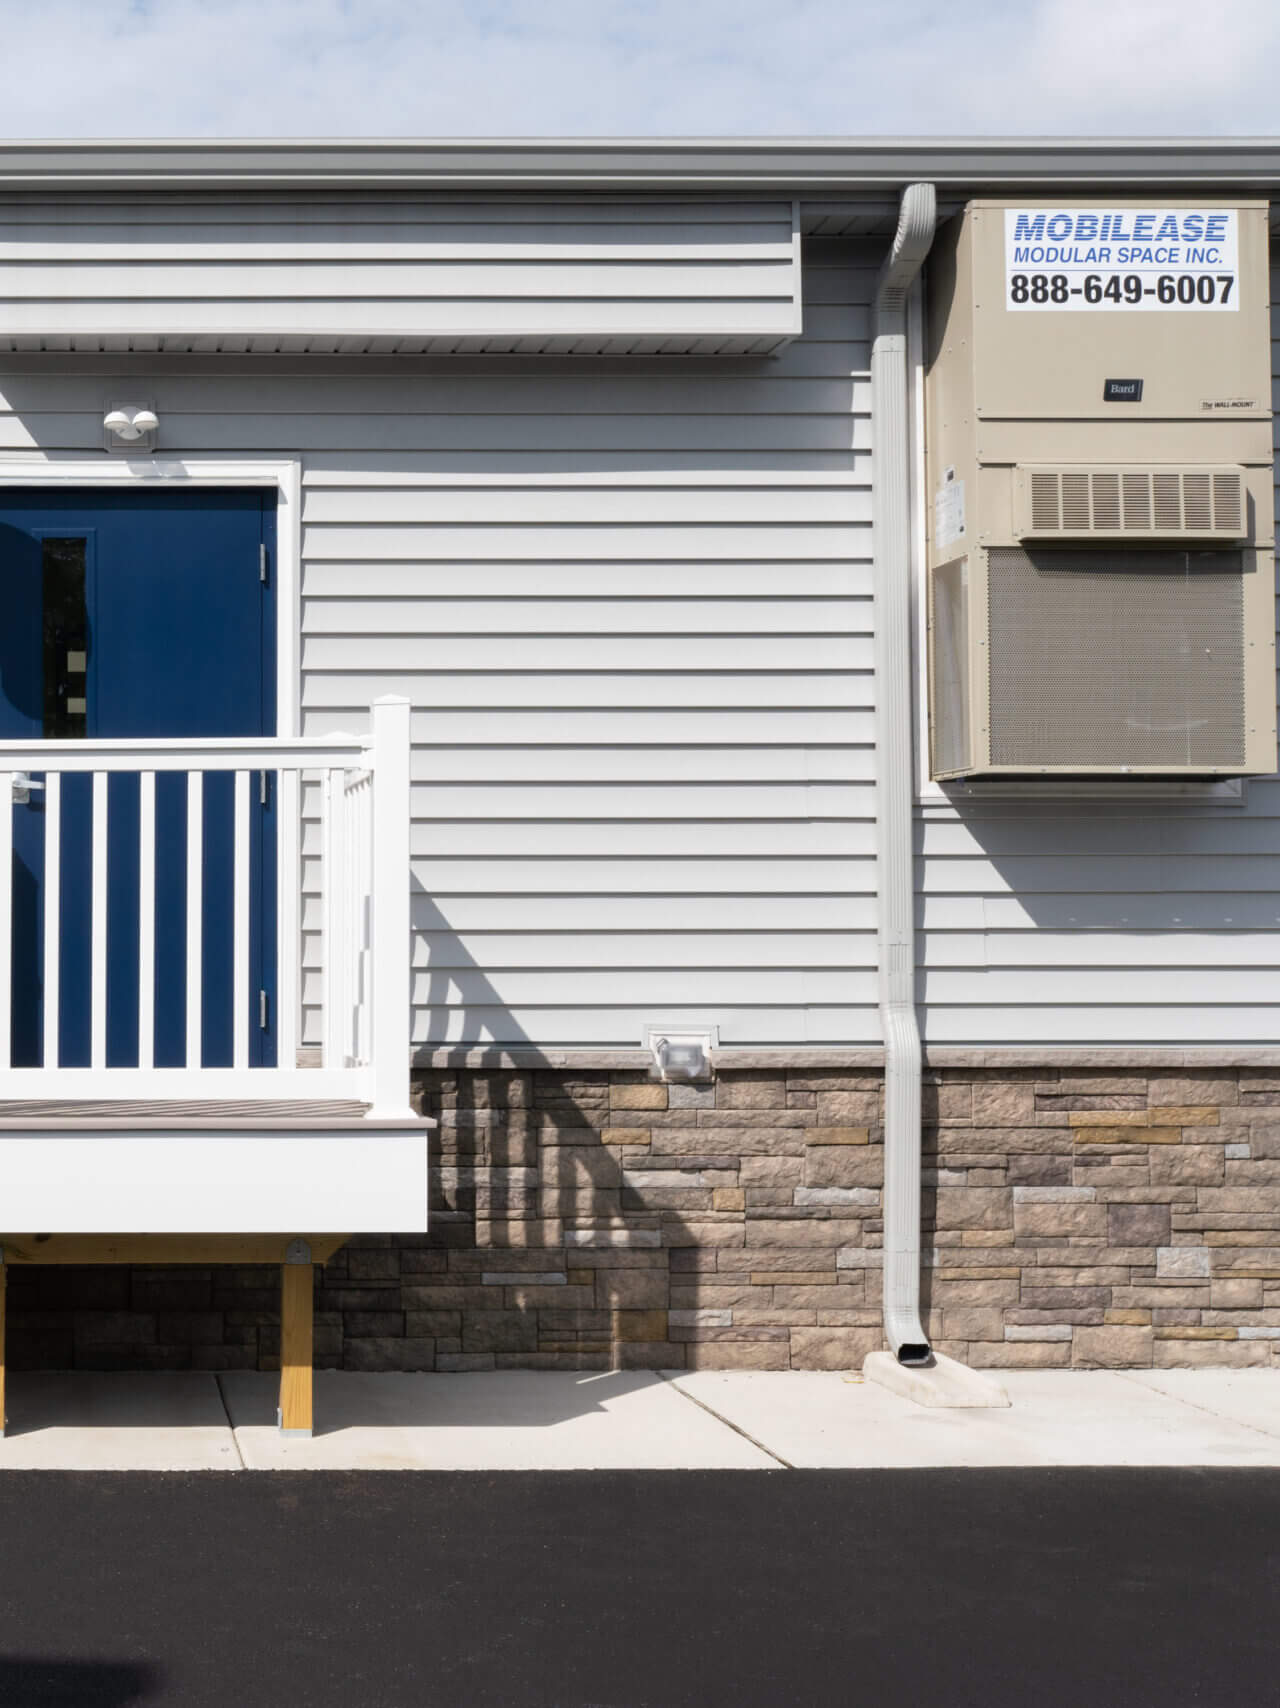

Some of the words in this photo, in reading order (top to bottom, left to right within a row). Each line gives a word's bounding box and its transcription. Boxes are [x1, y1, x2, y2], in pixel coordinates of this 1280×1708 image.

[1014, 214, 1229, 242] MOBILEASE
[1014, 247, 1111, 263] MODULAR
[1117, 247, 1180, 264] SPACE
[1185, 248, 1223, 264] INC.
[1011, 274, 1234, 304] 888-649-6007
[1111, 384, 1135, 393] Bard
